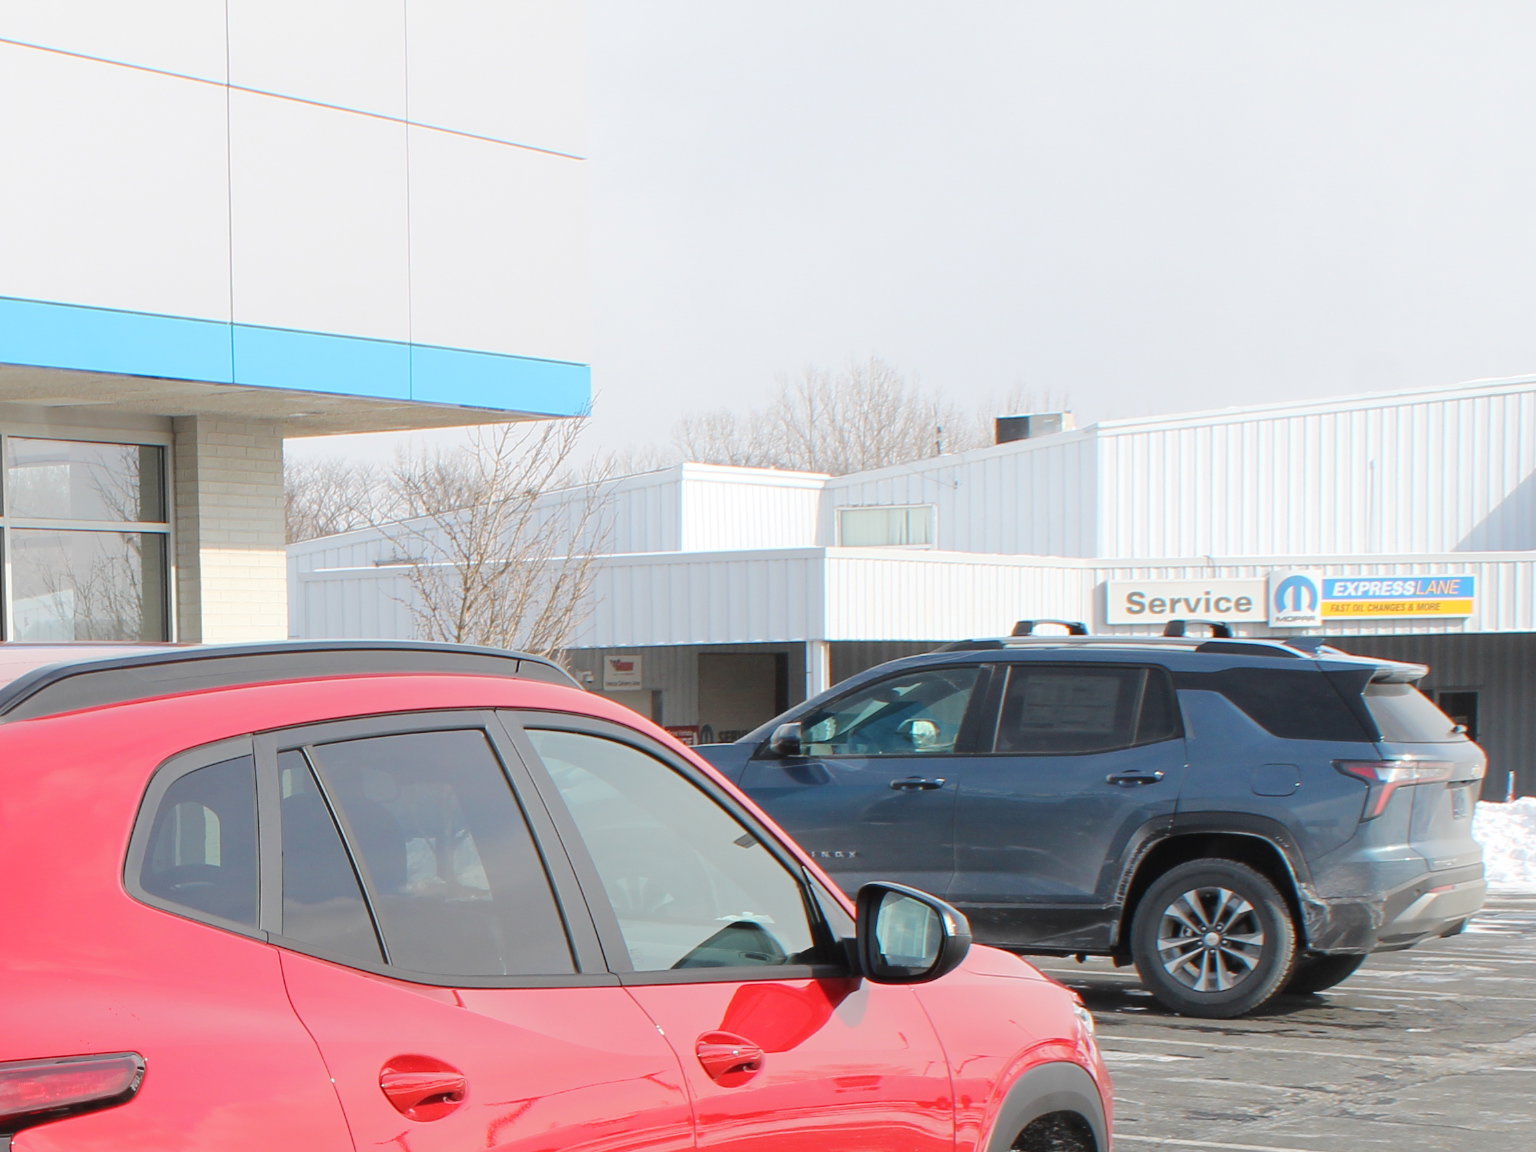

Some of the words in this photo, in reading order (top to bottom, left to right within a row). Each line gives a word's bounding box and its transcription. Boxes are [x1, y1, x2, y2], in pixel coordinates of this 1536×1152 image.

[1332, 579, 1462, 597] EXPRESSLANE
[1125, 591, 1253, 615] Service
[1330, 604, 1350, 613] FAST
[1353, 604, 1364, 612] OIL
[1367, 603, 1406, 612] CHANGES
[1416, 603, 1441, 611] MORE
